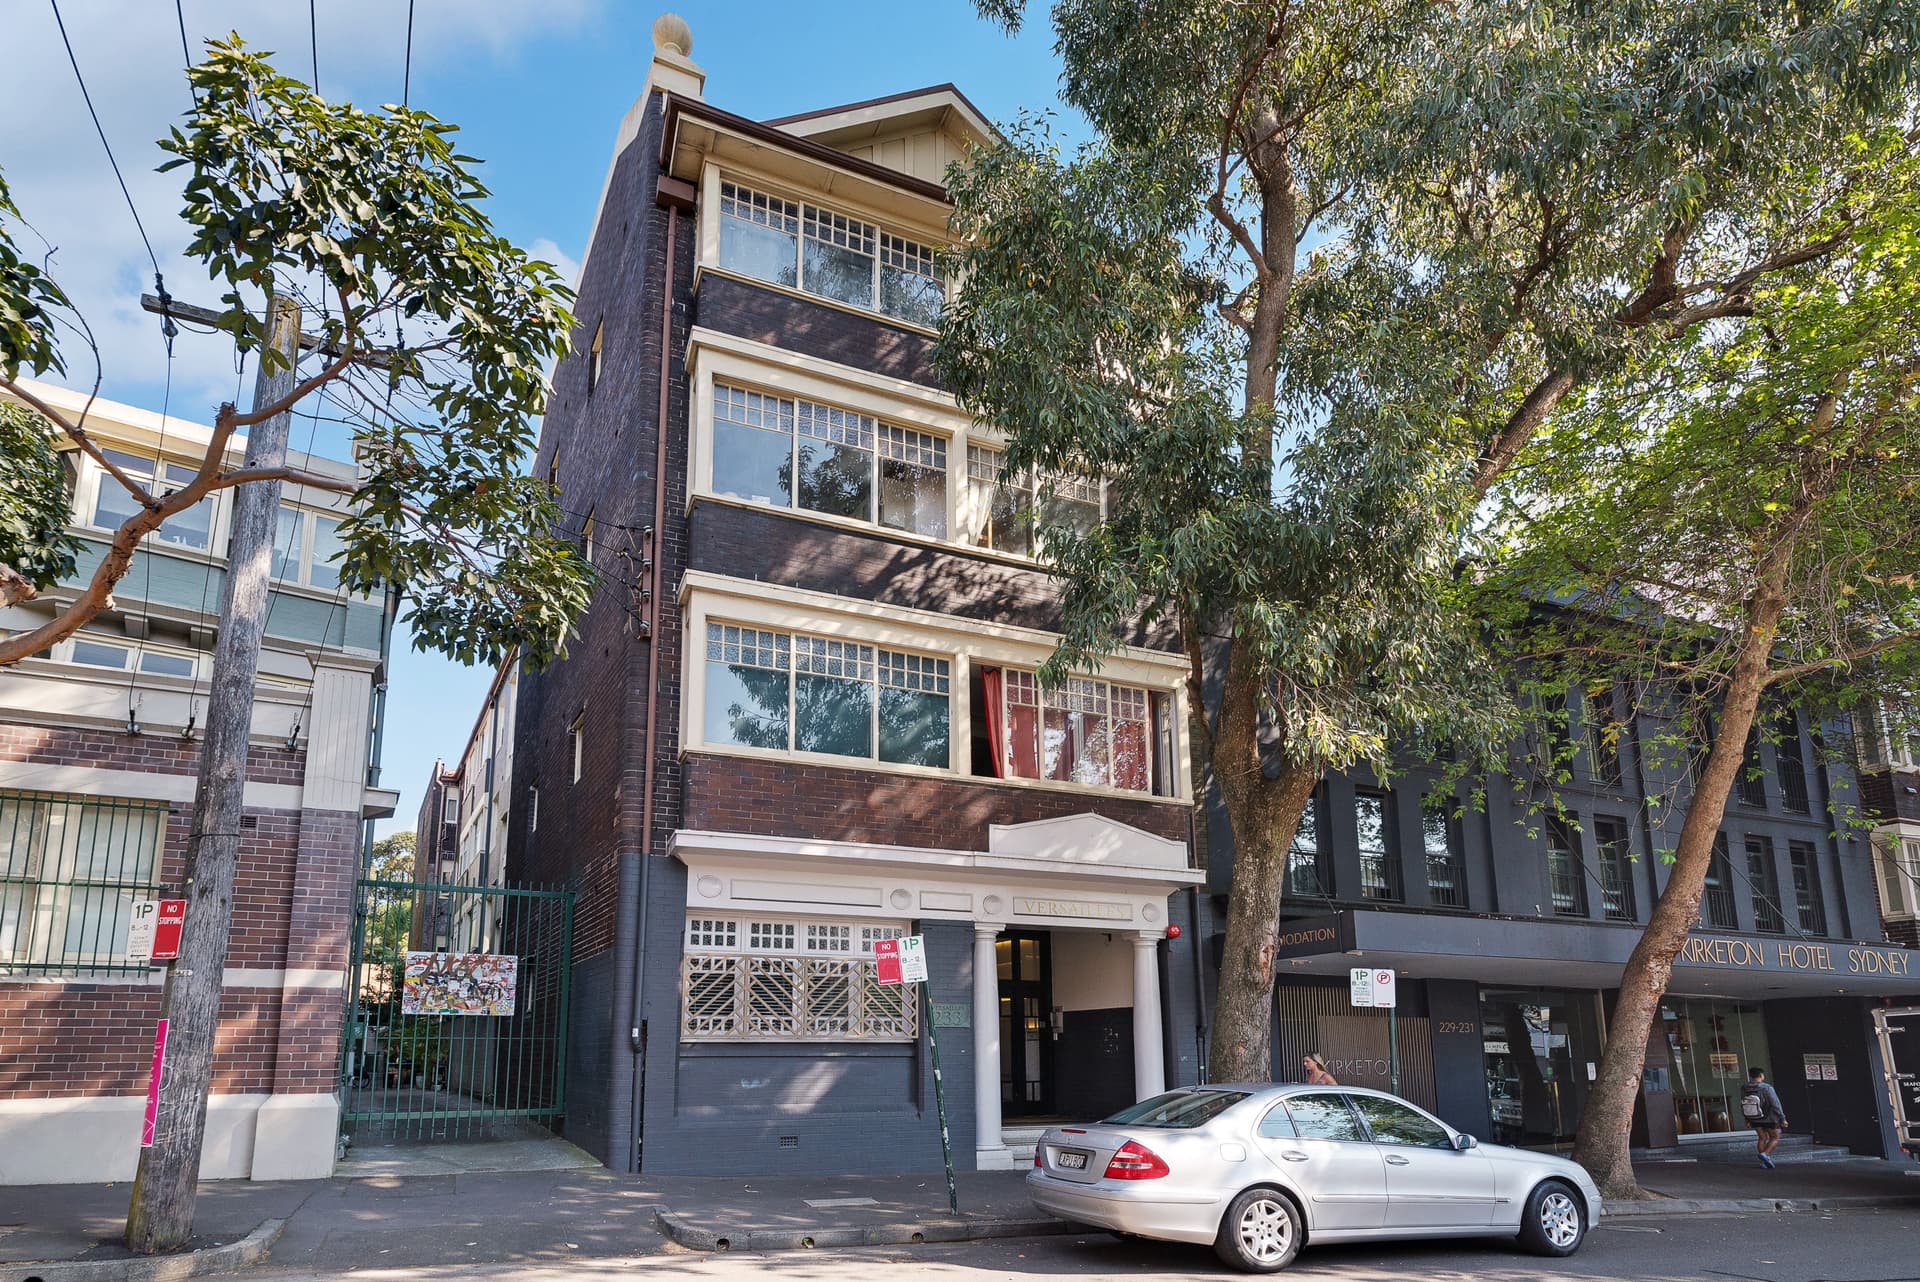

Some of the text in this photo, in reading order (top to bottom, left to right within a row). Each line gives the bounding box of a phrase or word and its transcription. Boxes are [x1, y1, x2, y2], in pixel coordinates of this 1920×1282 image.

[136, 904, 153, 919] 1P
[166, 905, 178, 913] NO
[1024, 900, 1126, 919] VERSAILLES
[158, 916, 182, 925] STOPPING
[902, 938, 919, 951] 1P
[1680, 937, 1909, 976] KIRKETON HOTEL SYDNEY
[1355, 970, 1368, 981] 1P
[1439, 1022, 1474, 1033] 229-231
